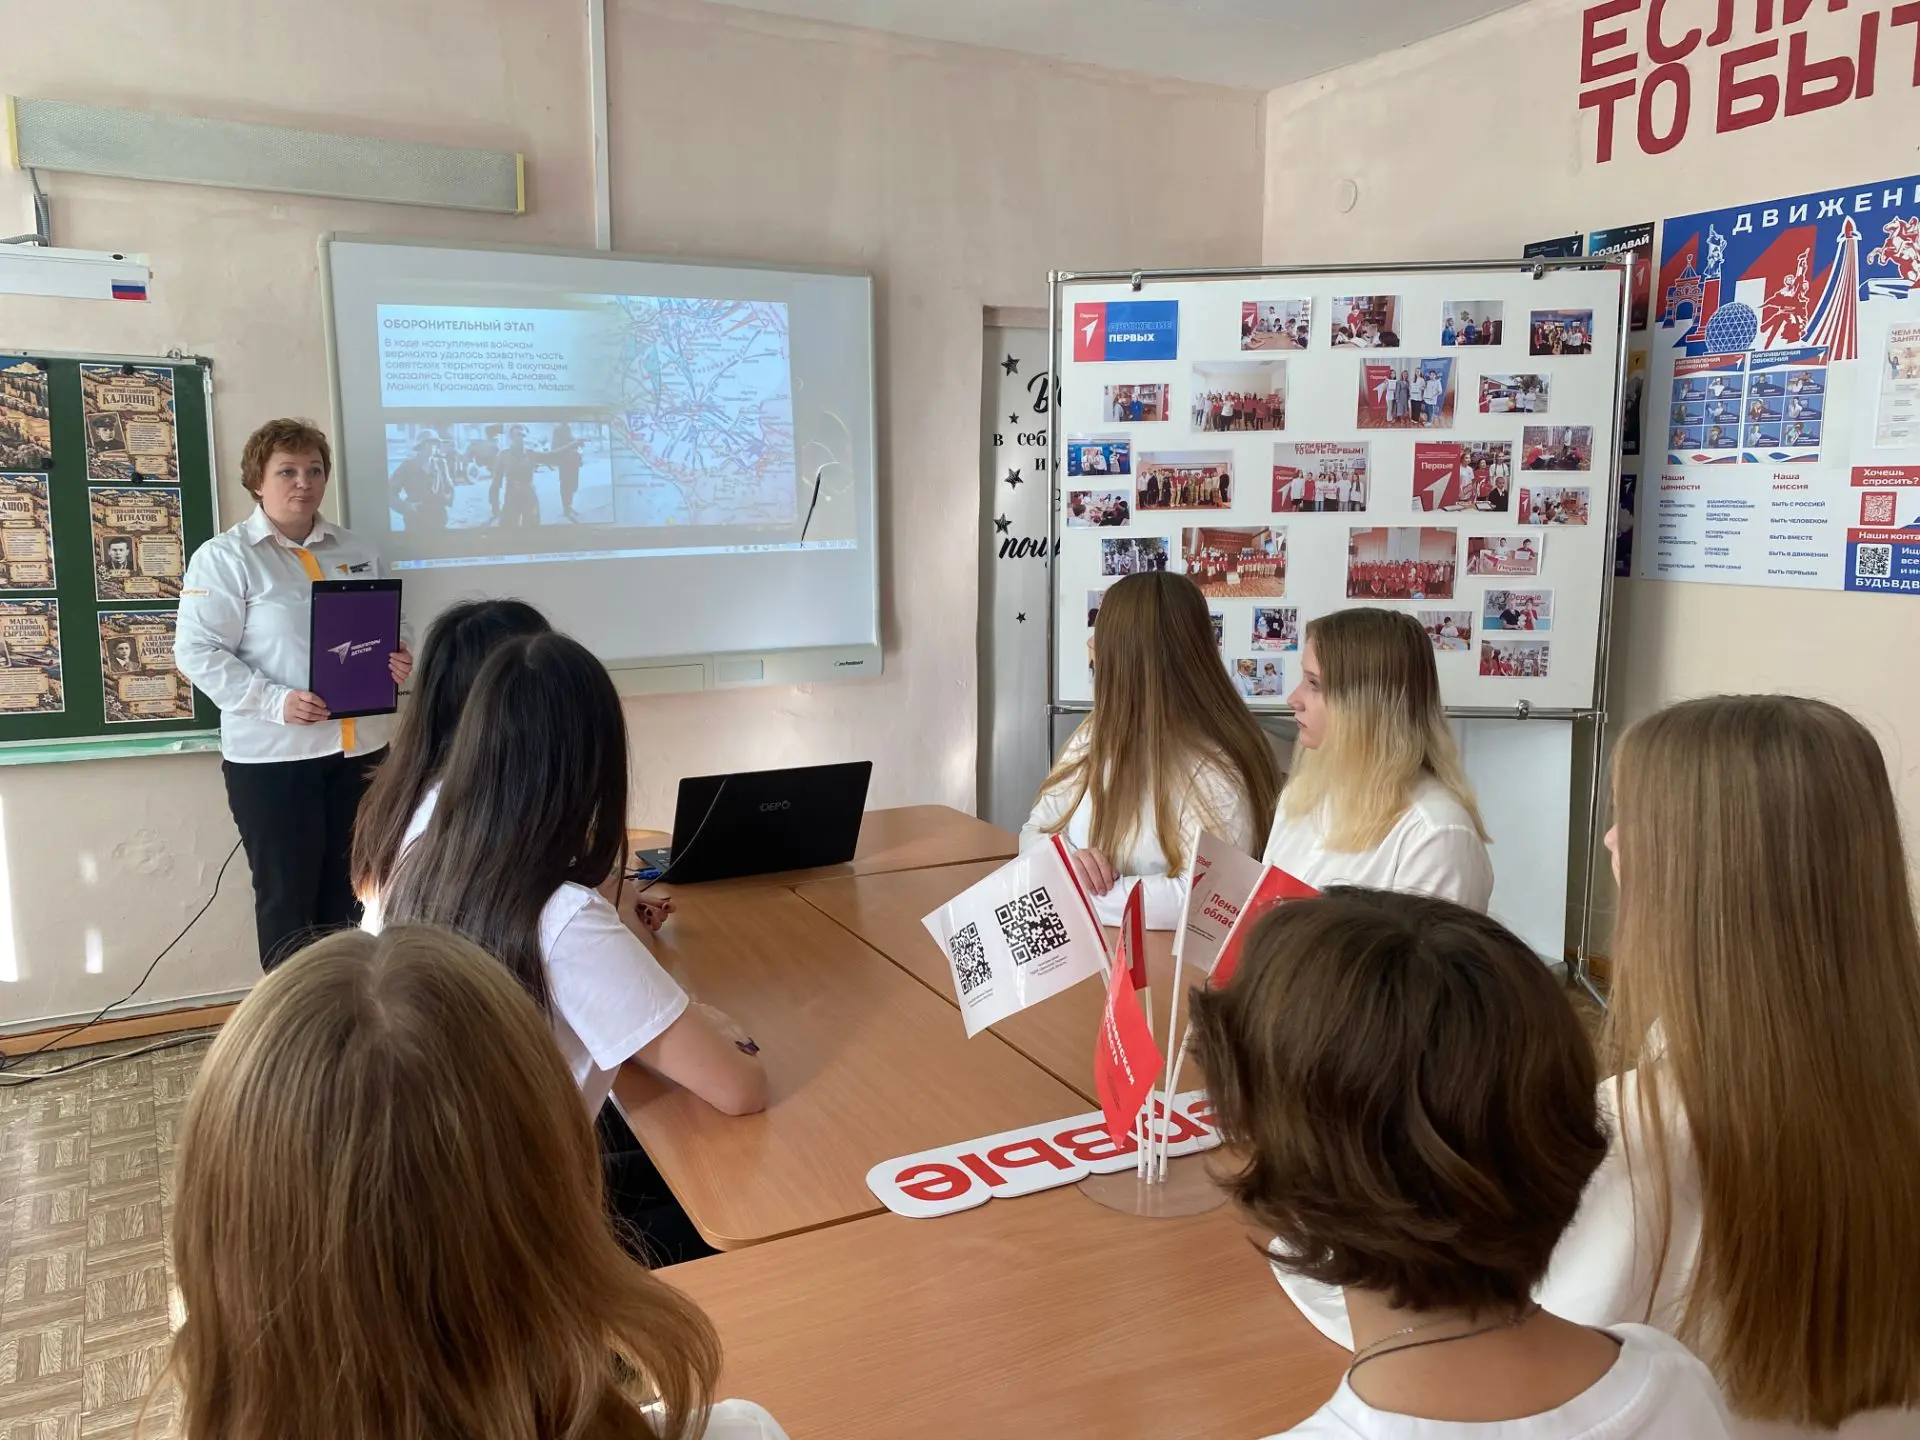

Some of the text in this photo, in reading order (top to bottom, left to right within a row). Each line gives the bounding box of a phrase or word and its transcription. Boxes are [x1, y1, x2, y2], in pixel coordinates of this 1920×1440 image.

[1580, 0, 1849, 84] ЕСЛ
[1579, 62, 1691, 163] ТО
[1732, 184, 1920, 236] ДВИЖЕН
[1592, 234, 1650, 257] СОЗДАВАЙ
[383, 318, 535, 332] ОБОРОНИТЕЛЬНЫЙ ЭТАП
[1109, 333, 1155, 342] ПЕРВЫХ
[1890, 335, 1920, 343] ЗАНЯТ
[102, 393, 156, 407] КАЛИНИН
[993, 429, 1049, 446] в себ
[1863, 468, 1904, 476] Хочешь
[1862, 477, 1919, 486] спросить?
[0, 502, 31, 513] АШОВ
[117, 514, 159, 522] ИГНАТОВ
[1855, 578, 1920, 590] БУДЬВДВ
